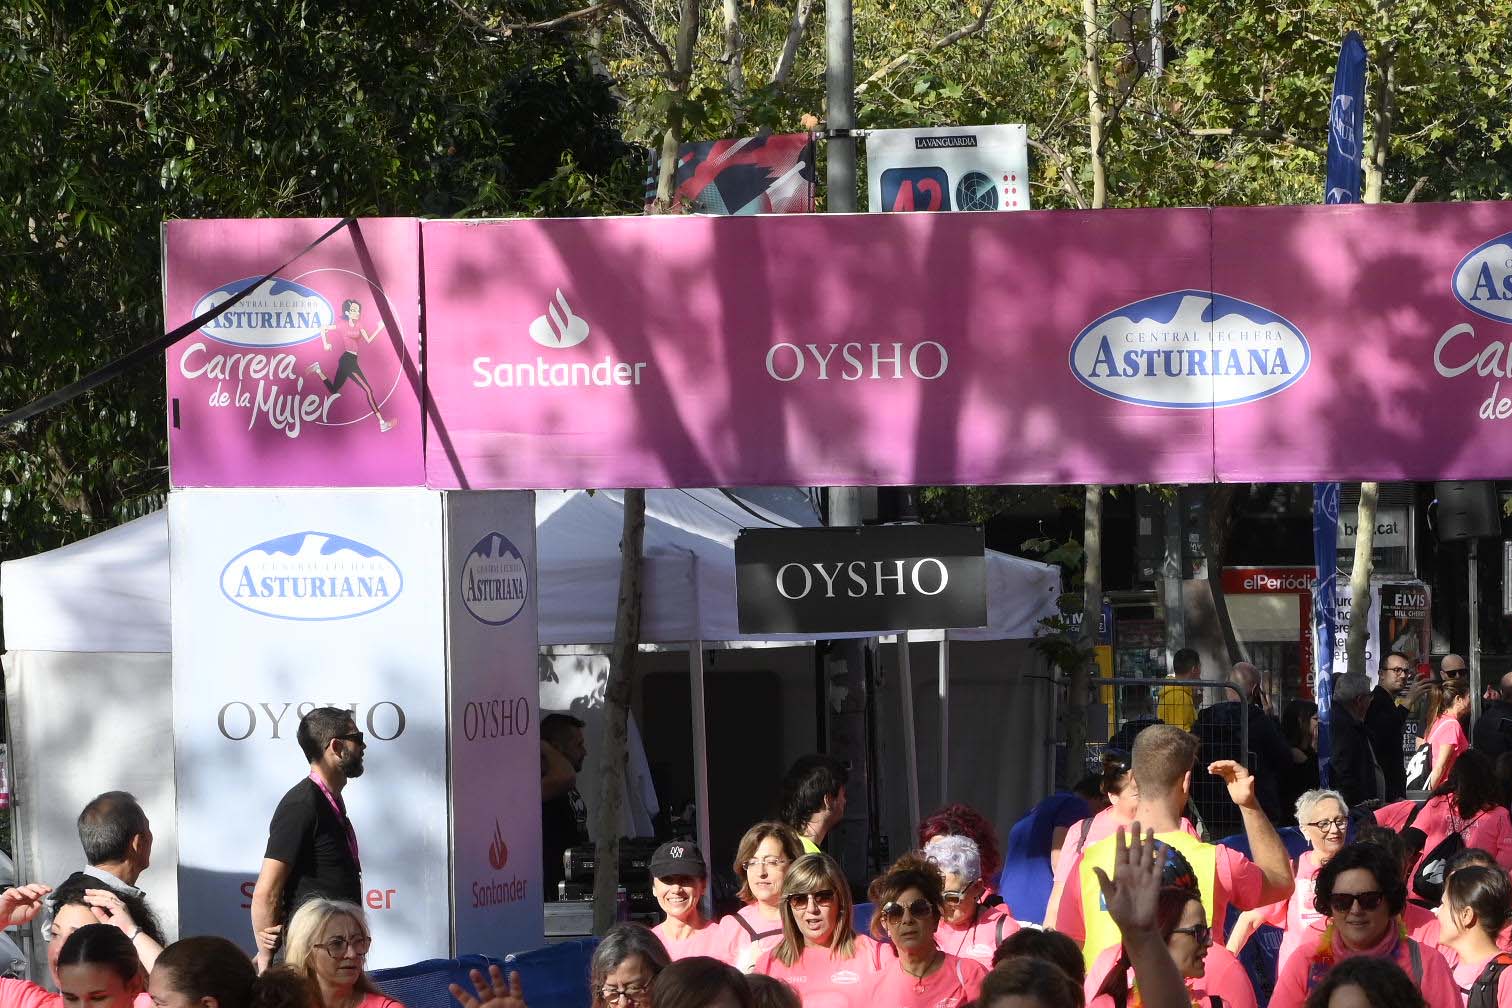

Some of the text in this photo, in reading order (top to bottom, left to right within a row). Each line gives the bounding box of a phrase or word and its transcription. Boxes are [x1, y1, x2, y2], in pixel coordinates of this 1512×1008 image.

[205, 302, 322, 328] ASTURIANA
[1126, 330, 1283, 343] CENTRAL LECHERA
[180, 343, 297, 379] Carrera
[473, 358, 646, 387] Santander
[766, 341, 949, 381] OYSHO
[1088, 335, 1291, 378] ASTURIANA
[209, 376, 341, 438] de la Mujer
[1479, 382, 1512, 420] de
[235, 565, 390, 598] ASTURIANA
[466, 567, 525, 602] ASTURIANA
[776, 558, 949, 599] OYSHO
[1395, 593, 1425, 607] ELVIS
[217, 701, 406, 741] OYO
[463, 697, 530, 742] OYSHO
[472, 876, 527, 908] Santander
